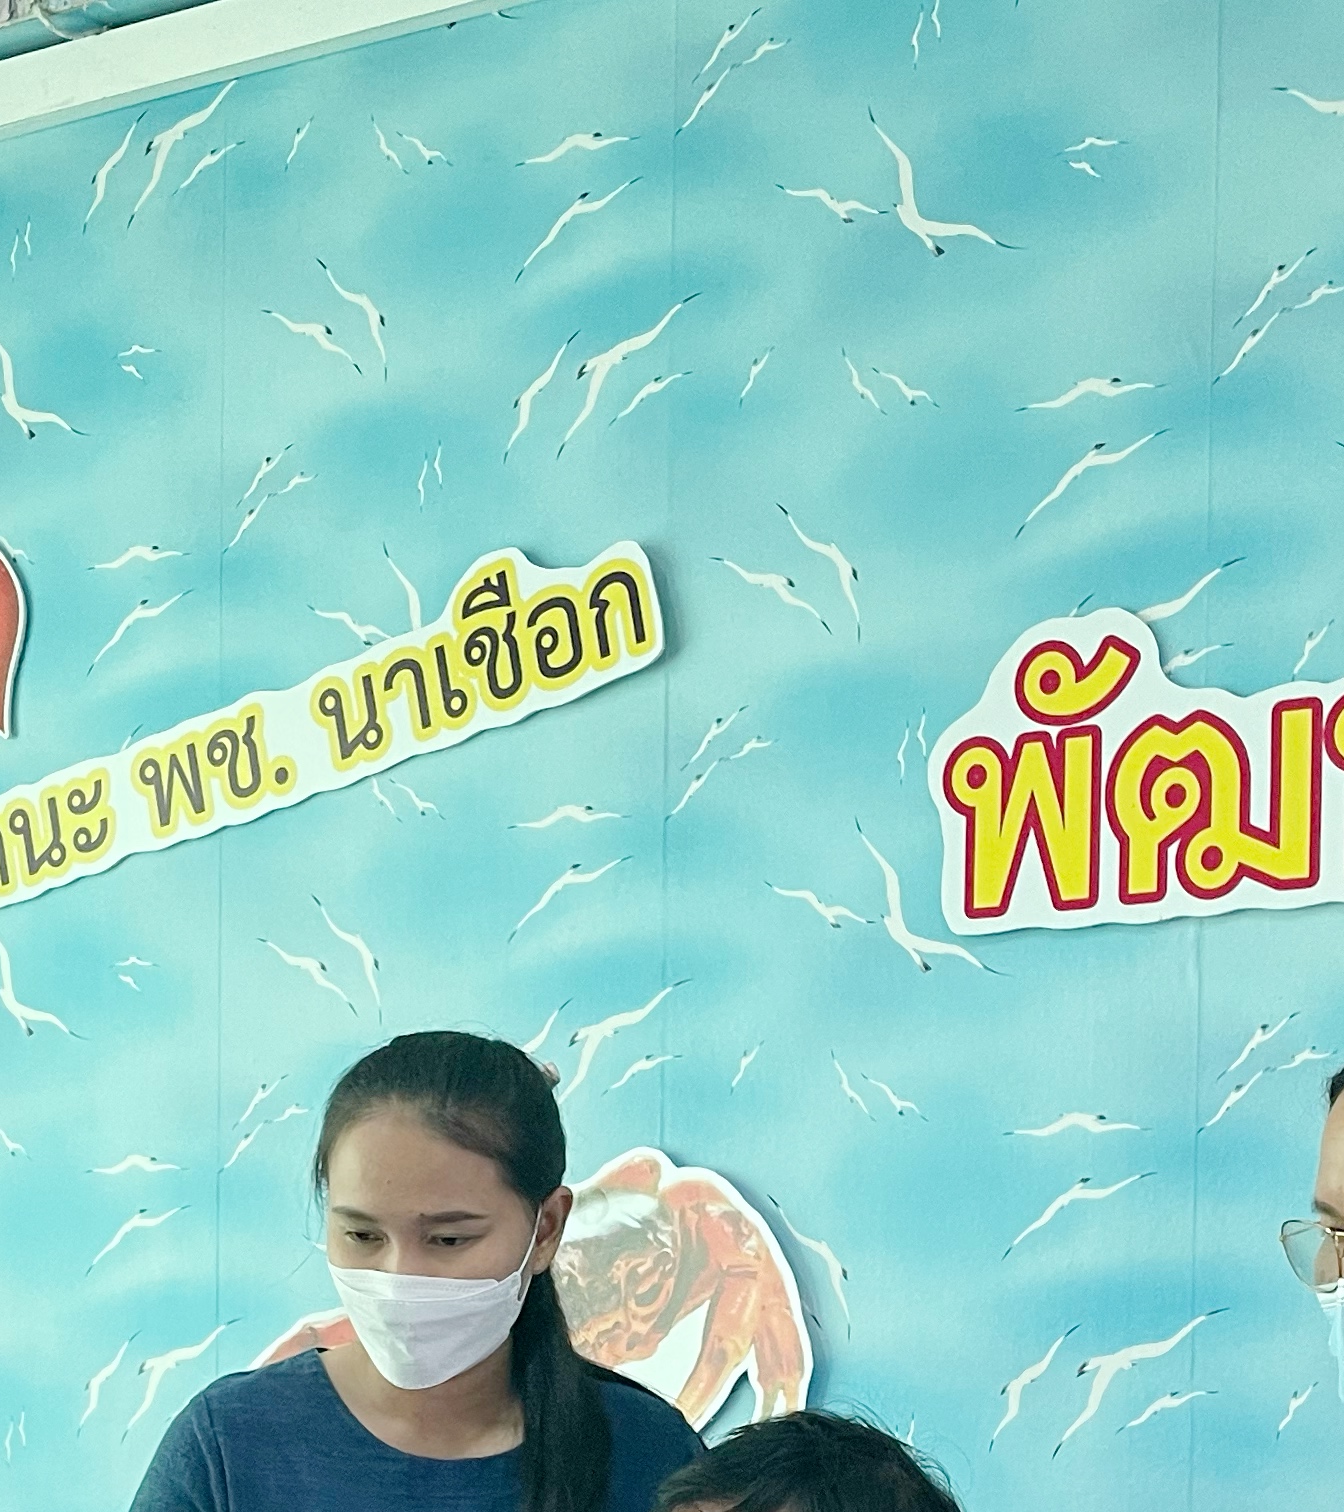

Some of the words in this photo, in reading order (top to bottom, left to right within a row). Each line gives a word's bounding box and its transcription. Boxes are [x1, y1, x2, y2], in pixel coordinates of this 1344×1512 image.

[139, 715, 293, 827] พช.
[319, 569, 647, 759] นาเชือก
